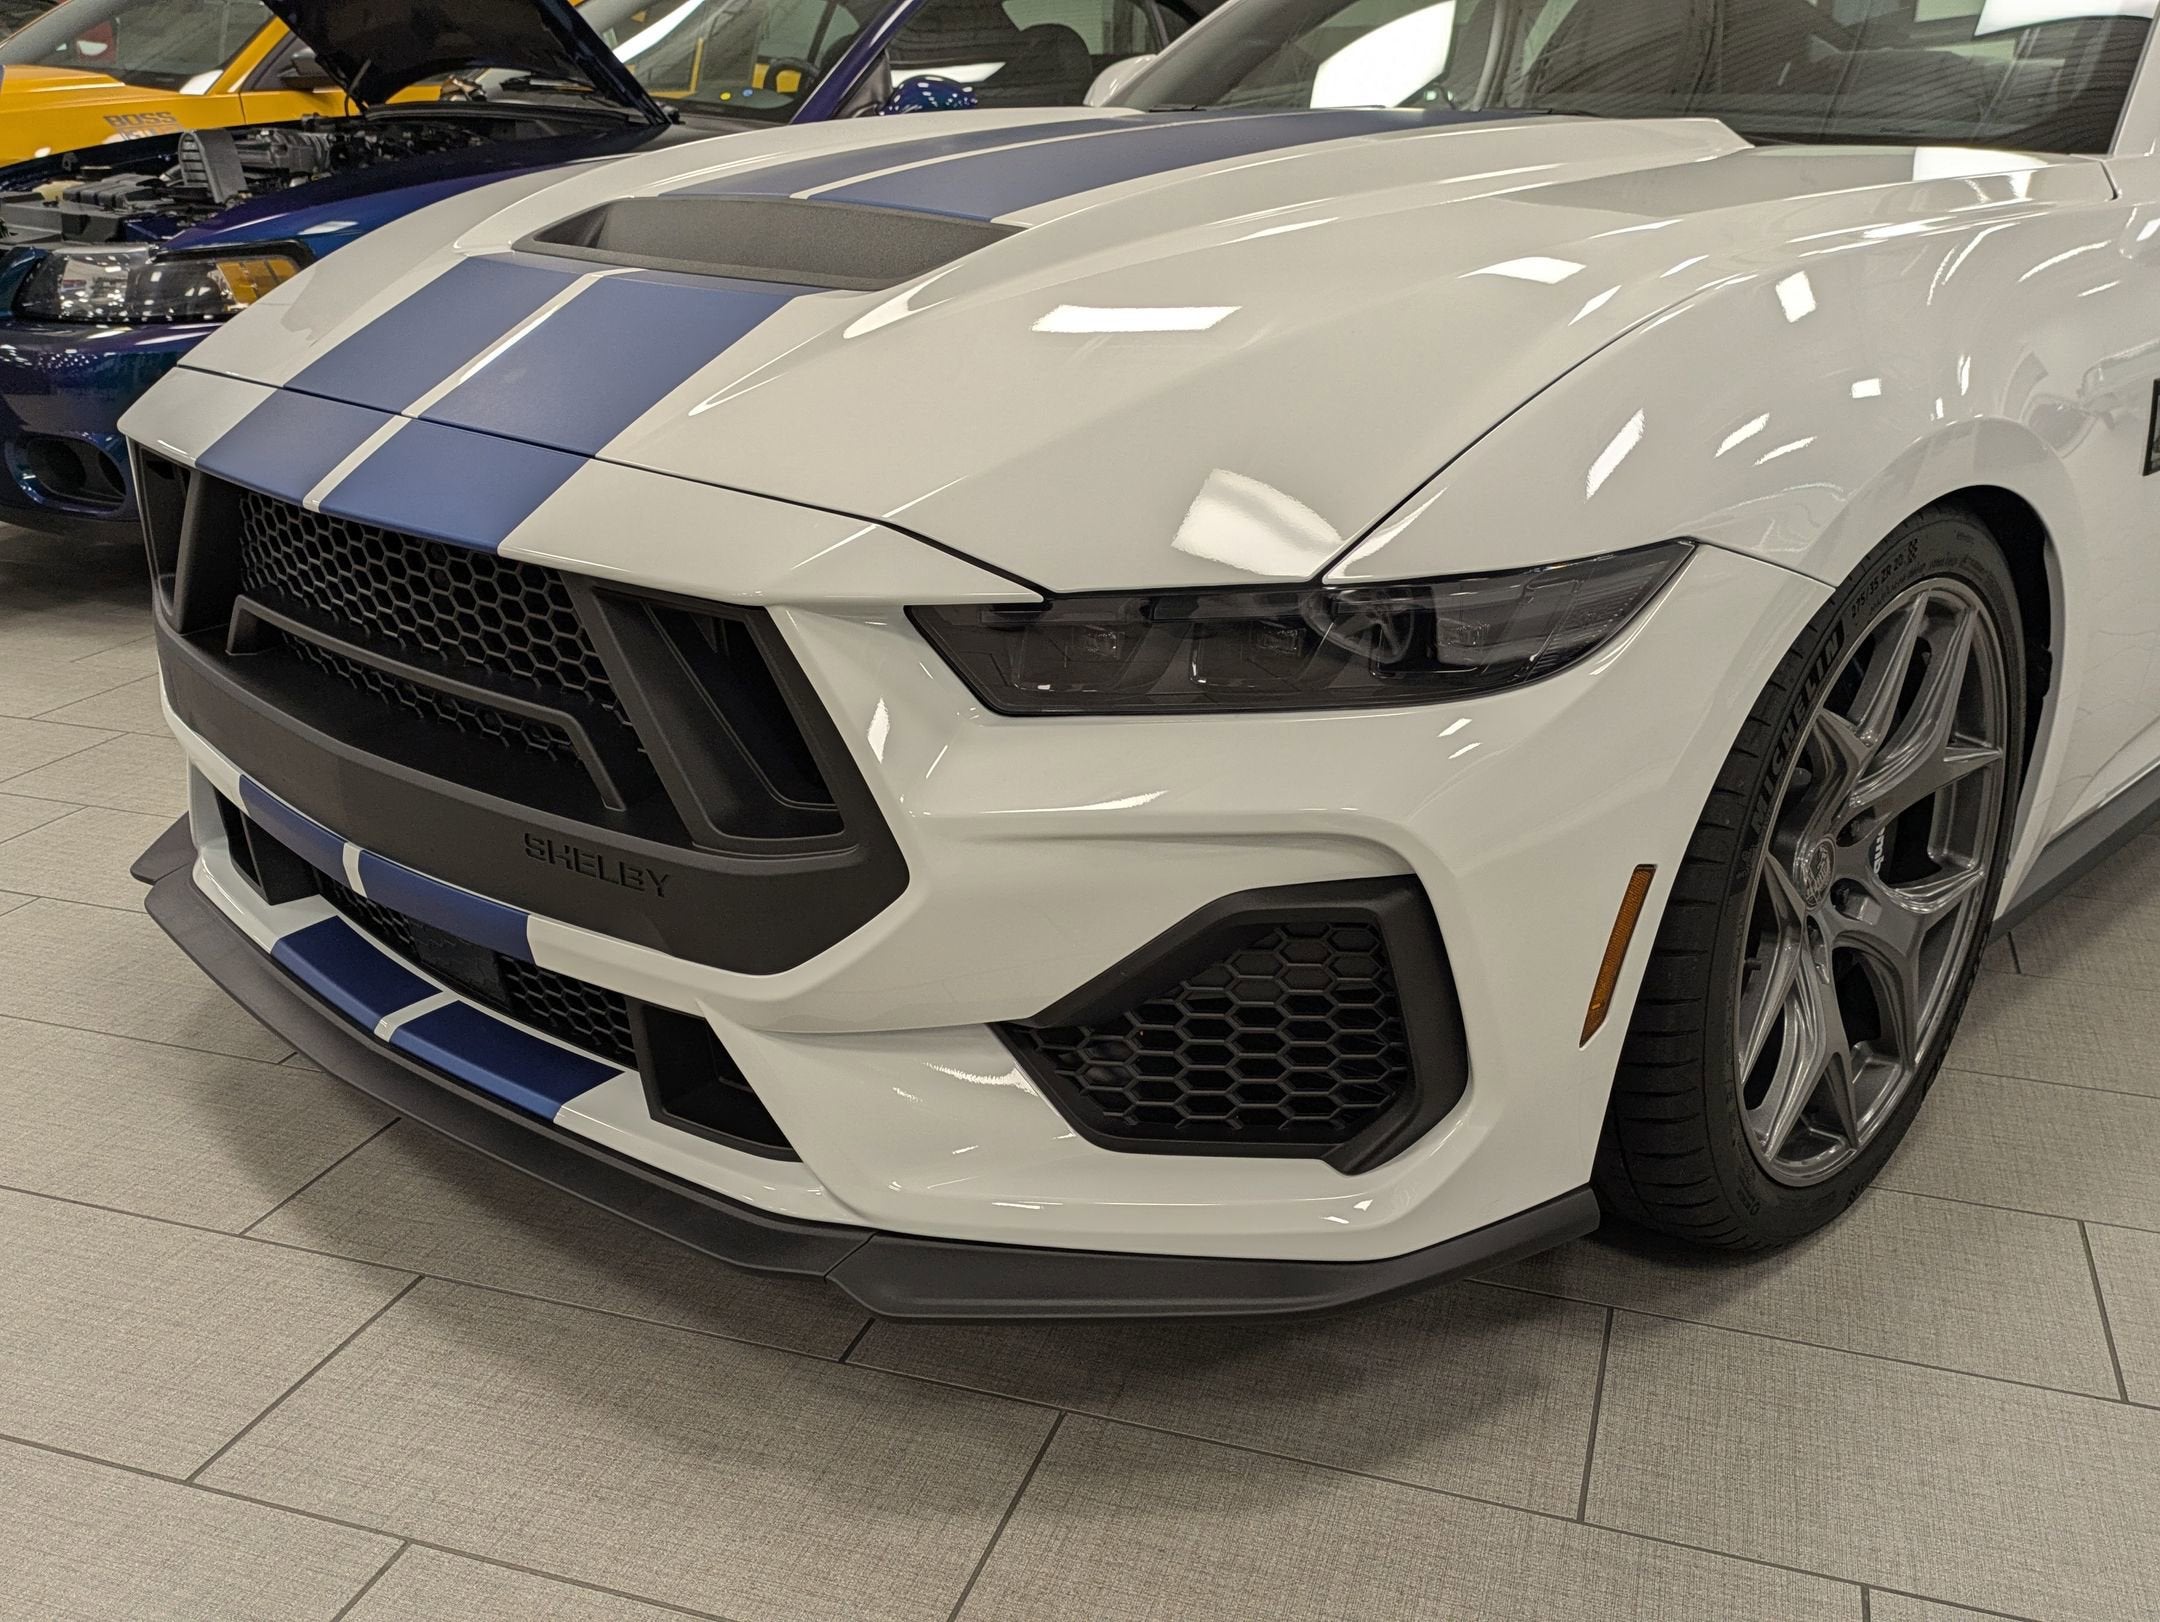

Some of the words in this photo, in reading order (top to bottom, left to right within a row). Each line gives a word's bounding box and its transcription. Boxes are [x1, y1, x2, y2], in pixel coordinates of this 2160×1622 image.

[103, 111, 177, 126] BOSS
[1751, 630, 1842, 833] MICHELIN
[524, 832, 669, 898] SHELBY
